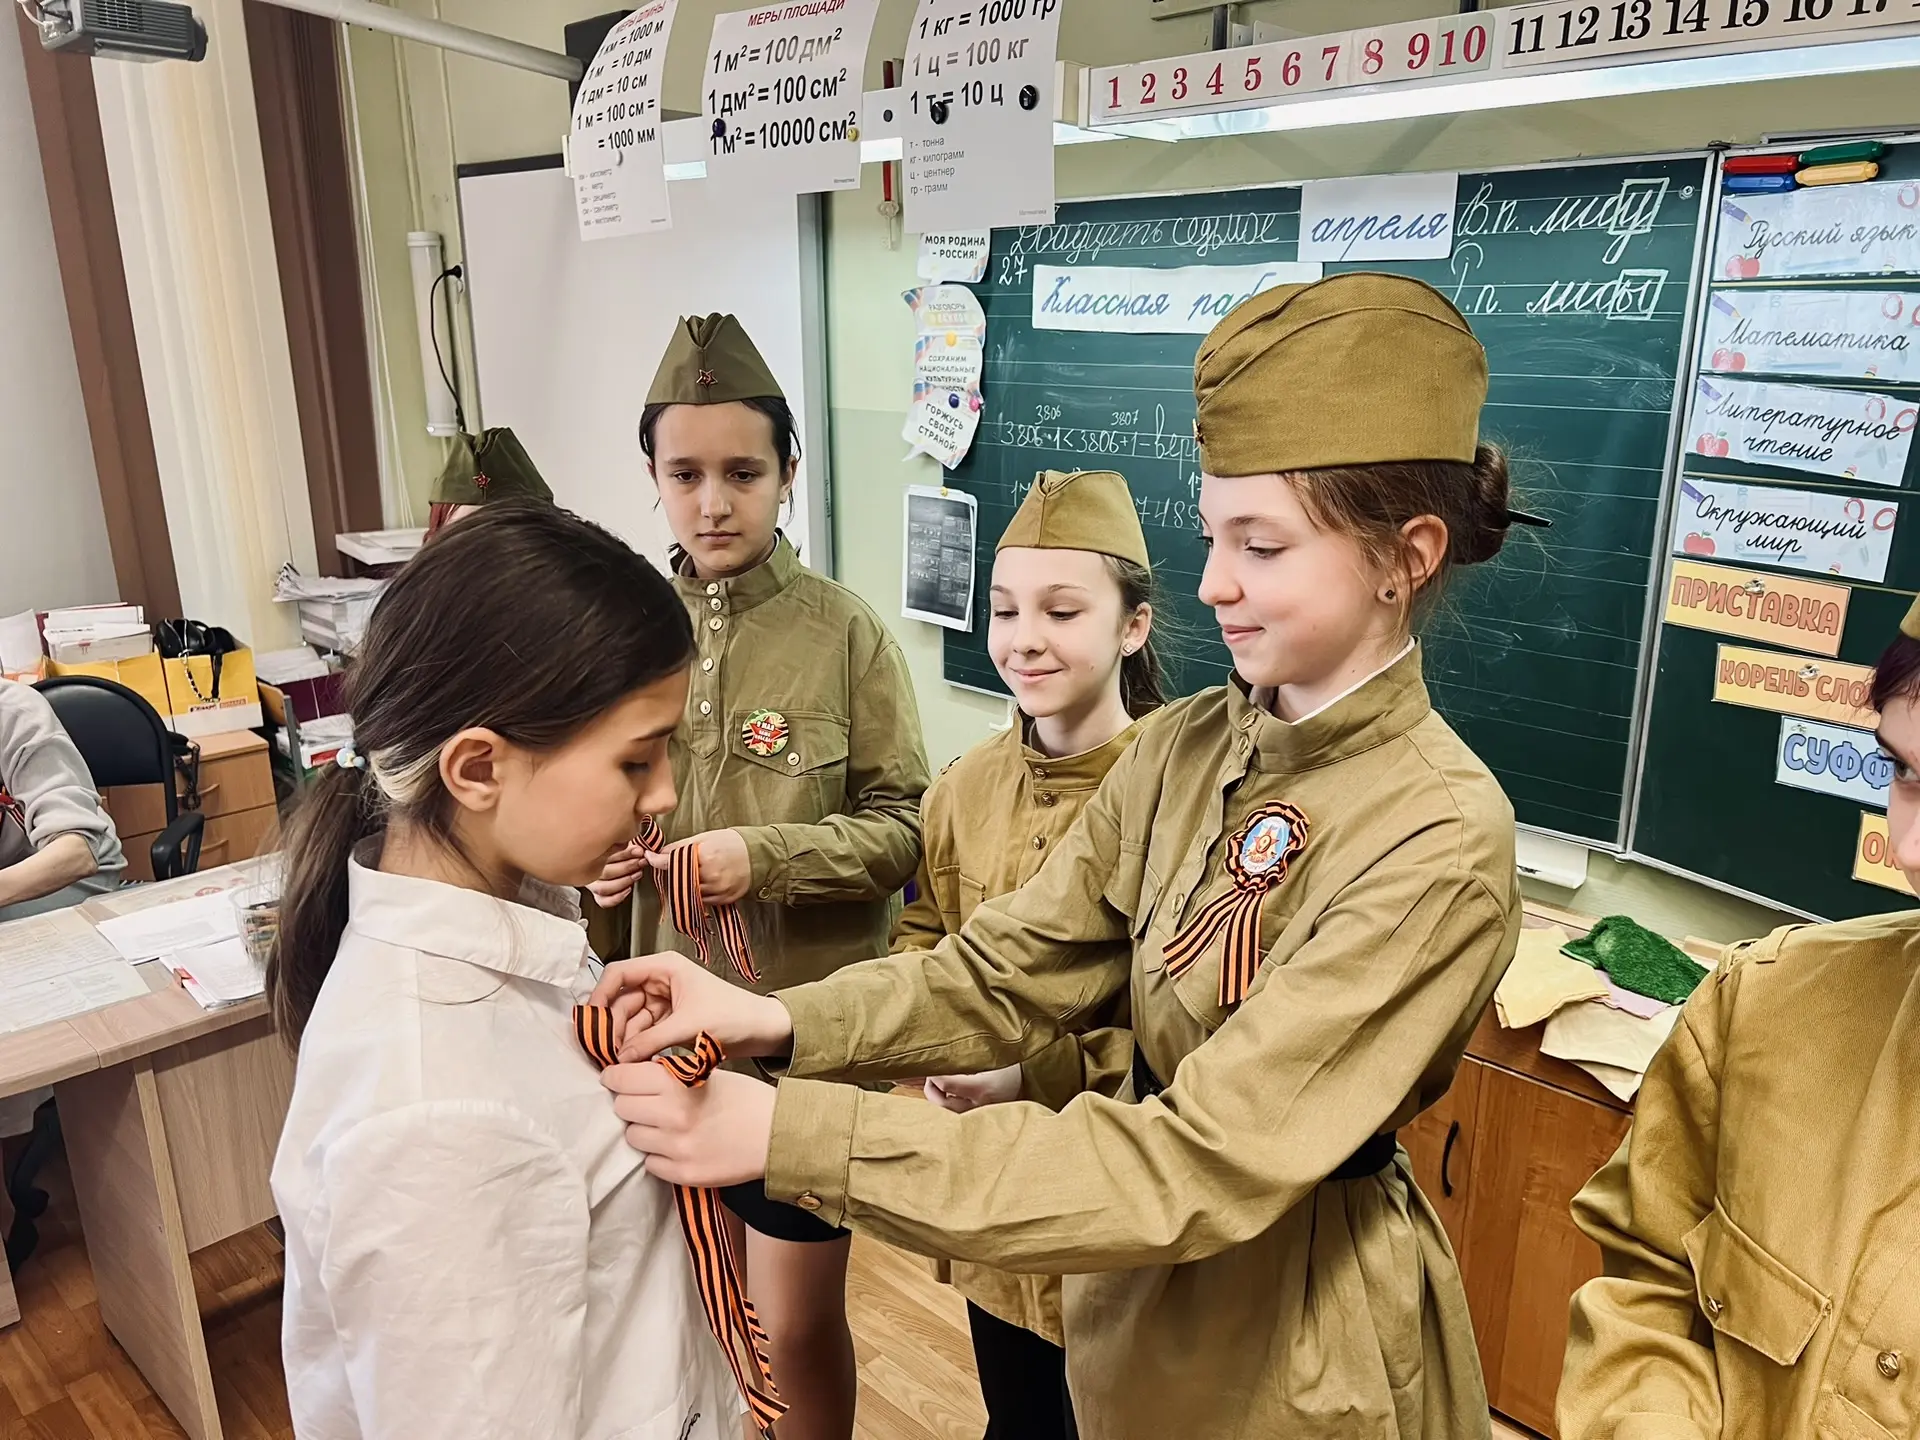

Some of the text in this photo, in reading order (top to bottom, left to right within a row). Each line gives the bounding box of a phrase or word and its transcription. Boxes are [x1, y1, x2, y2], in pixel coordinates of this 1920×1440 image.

[748, 0, 845, 27] МЕРЫ ПЛОЩАДИ
[920, 0, 1056, 40] 1 кг = 1000 гр
[1508, 16, 1546, 56] 11
[1555, 5, 1600, 49] 12
[1608, 0, 1651, 42] 13
[1662, 0, 1710, 36] 14
[1721, 0, 1770, 28] 15
[604, 41, 618, 55] км
[620, 36, 627, 45] =
[629, 22, 653, 44] 1000
[654, 20, 664, 33] м
[588, 48, 652, 80] 1 м = 10 дм
[713, 50, 721, 74] 1
[765, 36, 799, 65] 100
[913, 38, 1030, 77] 1 ц = 100 кг
[1108, 25, 1487, 109] 1 2 3 4 5 6 7 8 9 10
[581, 74, 648, 105] 1 дм = 10 см
[708, 90, 716, 115] 1
[758, 88, 770, 102] =
[773, 75, 806, 106] 100
[910, 80, 1004, 115] 1 т = 10 ц
[577, 99, 655, 130] 1 м = 100 см =
[598, 128, 656, 150] = 1000 мм
[745, 132, 756, 146] =
[760, 117, 815, 150] 10000
[910, 141, 914, 149] т
[922, 136, 945, 148] тонна
[910, 156, 917, 164] кг
[922, 150, 965, 164] килограмм
[910, 171, 916, 180] ц
[923, 166, 956, 178] центнер
[910, 186, 918, 196] гр
[924, 182, 949, 195] грамм
[925, 236, 986, 247] МОЯ РОДИНА
[1312, 213, 1448, 261] апреля
[1744, 220, 1918, 260] Русский язык
[940, 249, 978, 260] РОССИЯ!
[998, 255, 1028, 286] 27
[1041, 276, 1170, 316] Классная
[1718, 318, 1911, 351] Математика
[919, 366, 976, 374] НАЦИОНАЛЬНЫЕ
[925, 376, 968, 384] КУЛЬТУРНЫЕ
[925, 403, 964, 430] ГОРЖУСЬ
[928, 417, 956, 438] СВОЕЙ
[1035, 404, 1139, 426] 3806 3807
[1706, 392, 1901, 444] Литературное
[918, 425, 958, 454] СТРАНОЙ!
[1744, 435, 1834, 462] чтение
[1696, 494, 1867, 540] Окружающий
[1746, 535, 1802, 562] мир
[1671, 575, 1840, 636] ПРИСТАВКА
[1718, 659, 1810, 698] КОРЕНЬ
